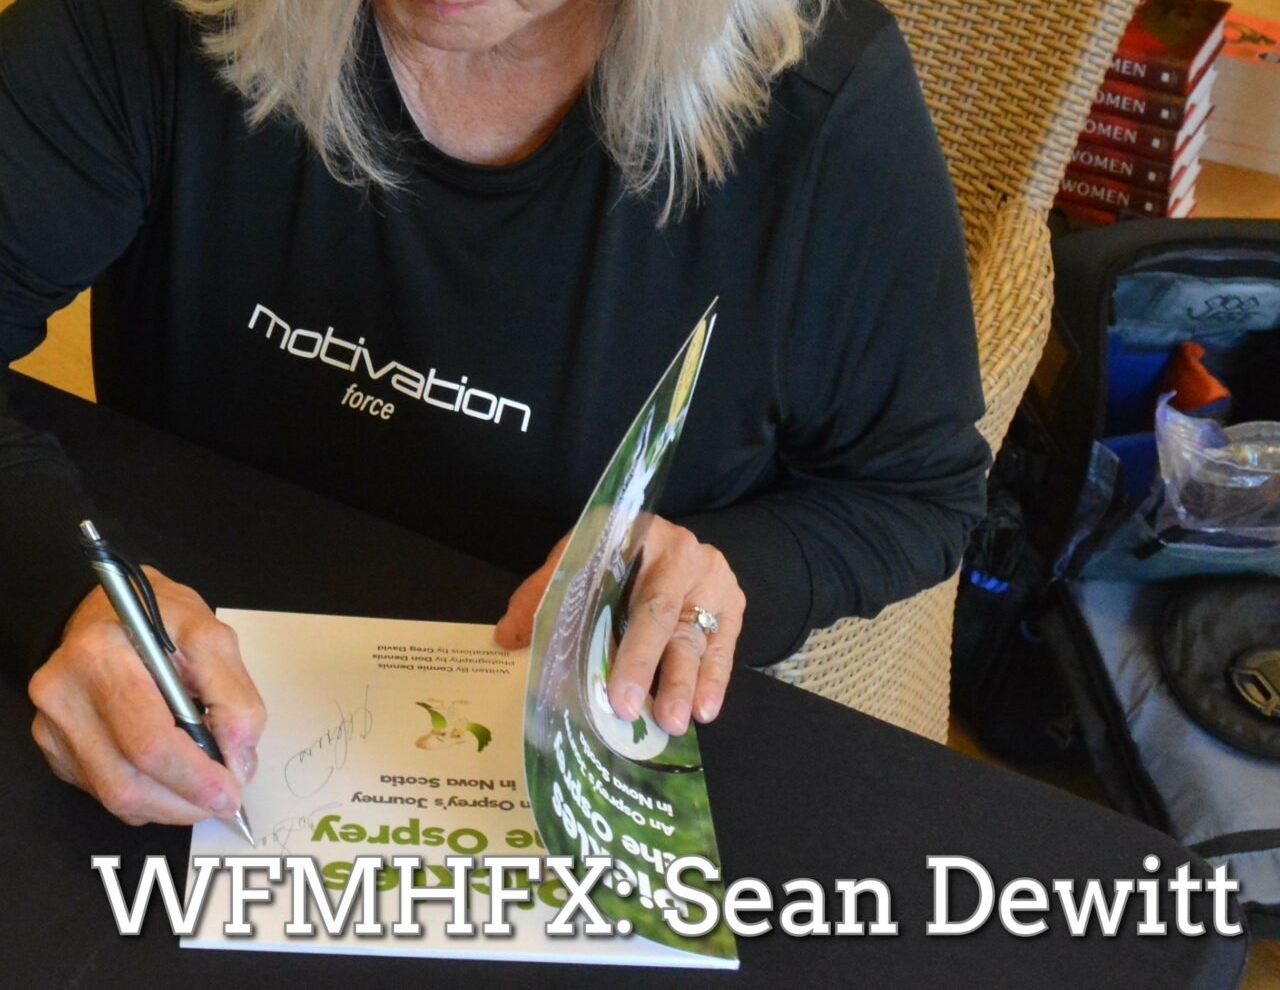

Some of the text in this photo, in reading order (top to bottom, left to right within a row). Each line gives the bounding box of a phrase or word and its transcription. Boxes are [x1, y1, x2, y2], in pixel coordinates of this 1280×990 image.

[1110, 57, 1147, 78] MEN
[1094, 89, 1147, 114] OMEN
[1083, 120, 1138, 144] OMEN
[1060, 179, 1131, 206] WOMEN
[248, 303, 532, 433] motivation
[341, 383, 396, 420] force
[372, 652, 409, 661] Dennis
[377, 644, 407, 653] David
[409, 645, 435, 654] Greg
[411, 654, 433, 663] Don
[377, 662, 414, 671] Dennis
[417, 664, 454, 673] Connie
[379, 774, 517, 792] in Nova Scotia
[612, 775, 654, 810] Nova
[351, 791, 515, 812] Osprey's Journey
[587, 772, 646, 826] Osprey's
[656, 799, 675, 818] in
[311, 814, 489, 855] Osprey
[650, 818, 676, 838] An
